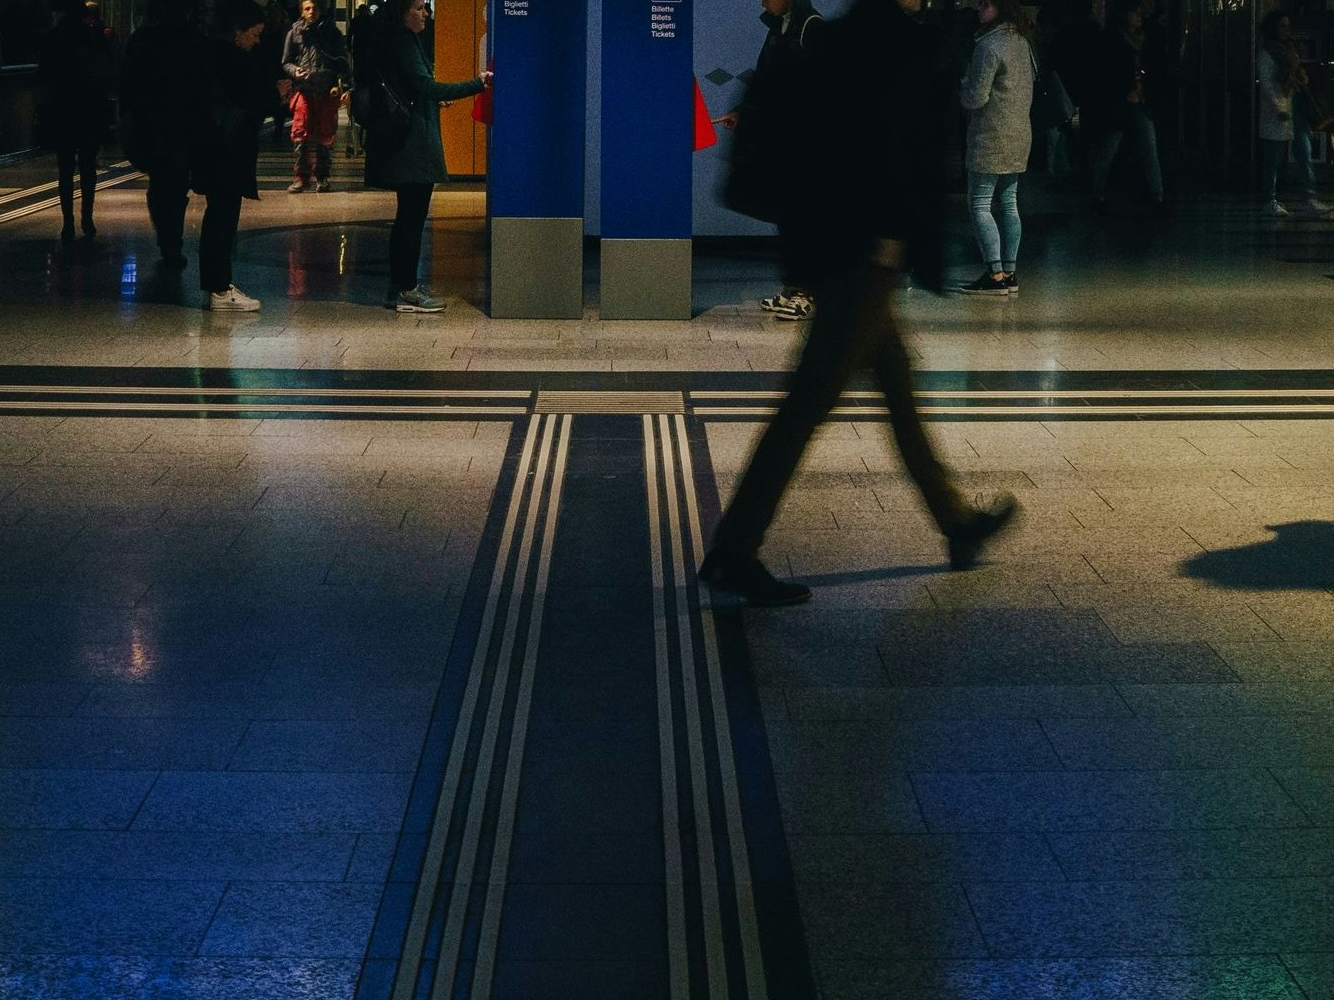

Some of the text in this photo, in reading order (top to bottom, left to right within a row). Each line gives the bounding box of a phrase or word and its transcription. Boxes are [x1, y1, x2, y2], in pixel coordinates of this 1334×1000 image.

[504, 0, 529, 8] Biglietti
[651, 5, 674, 13] Billette
[651, 22, 676, 30] Biglietti
